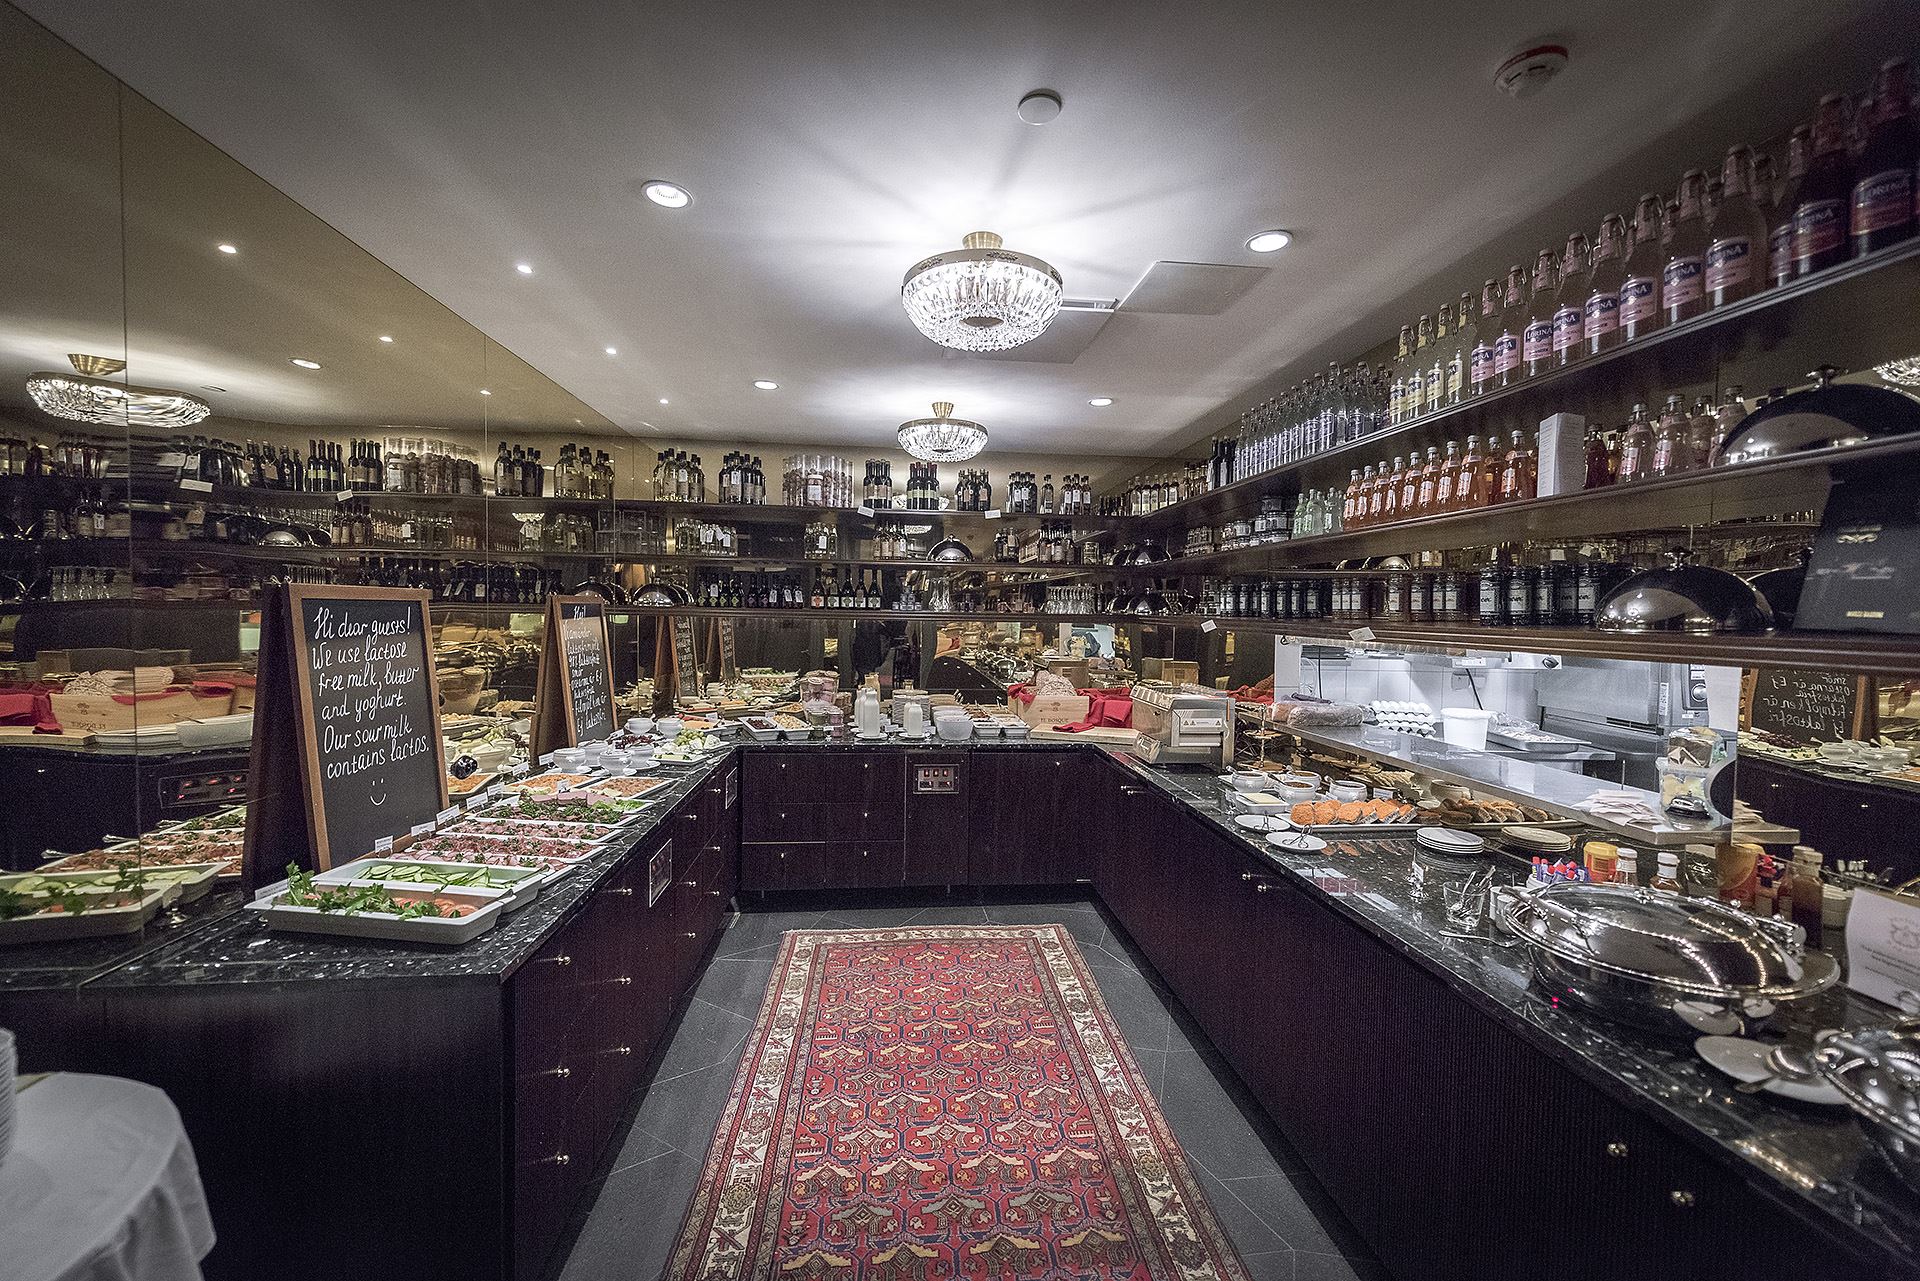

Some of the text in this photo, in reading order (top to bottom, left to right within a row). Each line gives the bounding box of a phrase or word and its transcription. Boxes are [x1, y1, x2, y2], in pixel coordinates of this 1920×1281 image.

[313, 606, 411, 645] Hi dear guests!
[312, 634, 408, 670] We use lactose
[318, 660, 420, 697] free milk, butter
[321, 688, 407, 723] and yoghurt.
[324, 714, 413, 754] Our sour milk
[327, 735, 430, 779] contains lactos.
